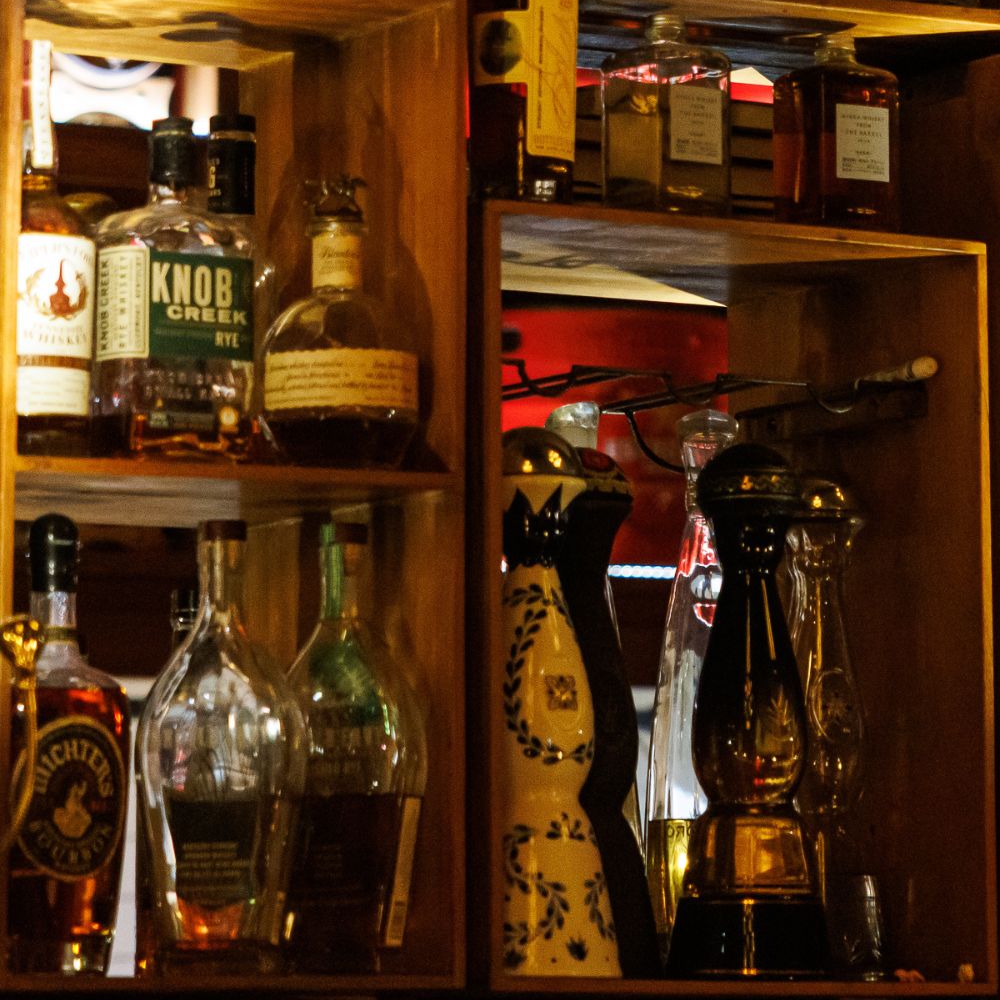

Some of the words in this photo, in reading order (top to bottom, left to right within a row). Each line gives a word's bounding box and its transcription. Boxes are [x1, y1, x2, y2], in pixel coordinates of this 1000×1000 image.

[100, 260, 110, 305] CREEK
[152, 261, 233, 308] KNOB
[100, 311, 110, 351] KNOB
[166, 304, 248, 326] CREEK
[214, 329, 240, 348] RYE
